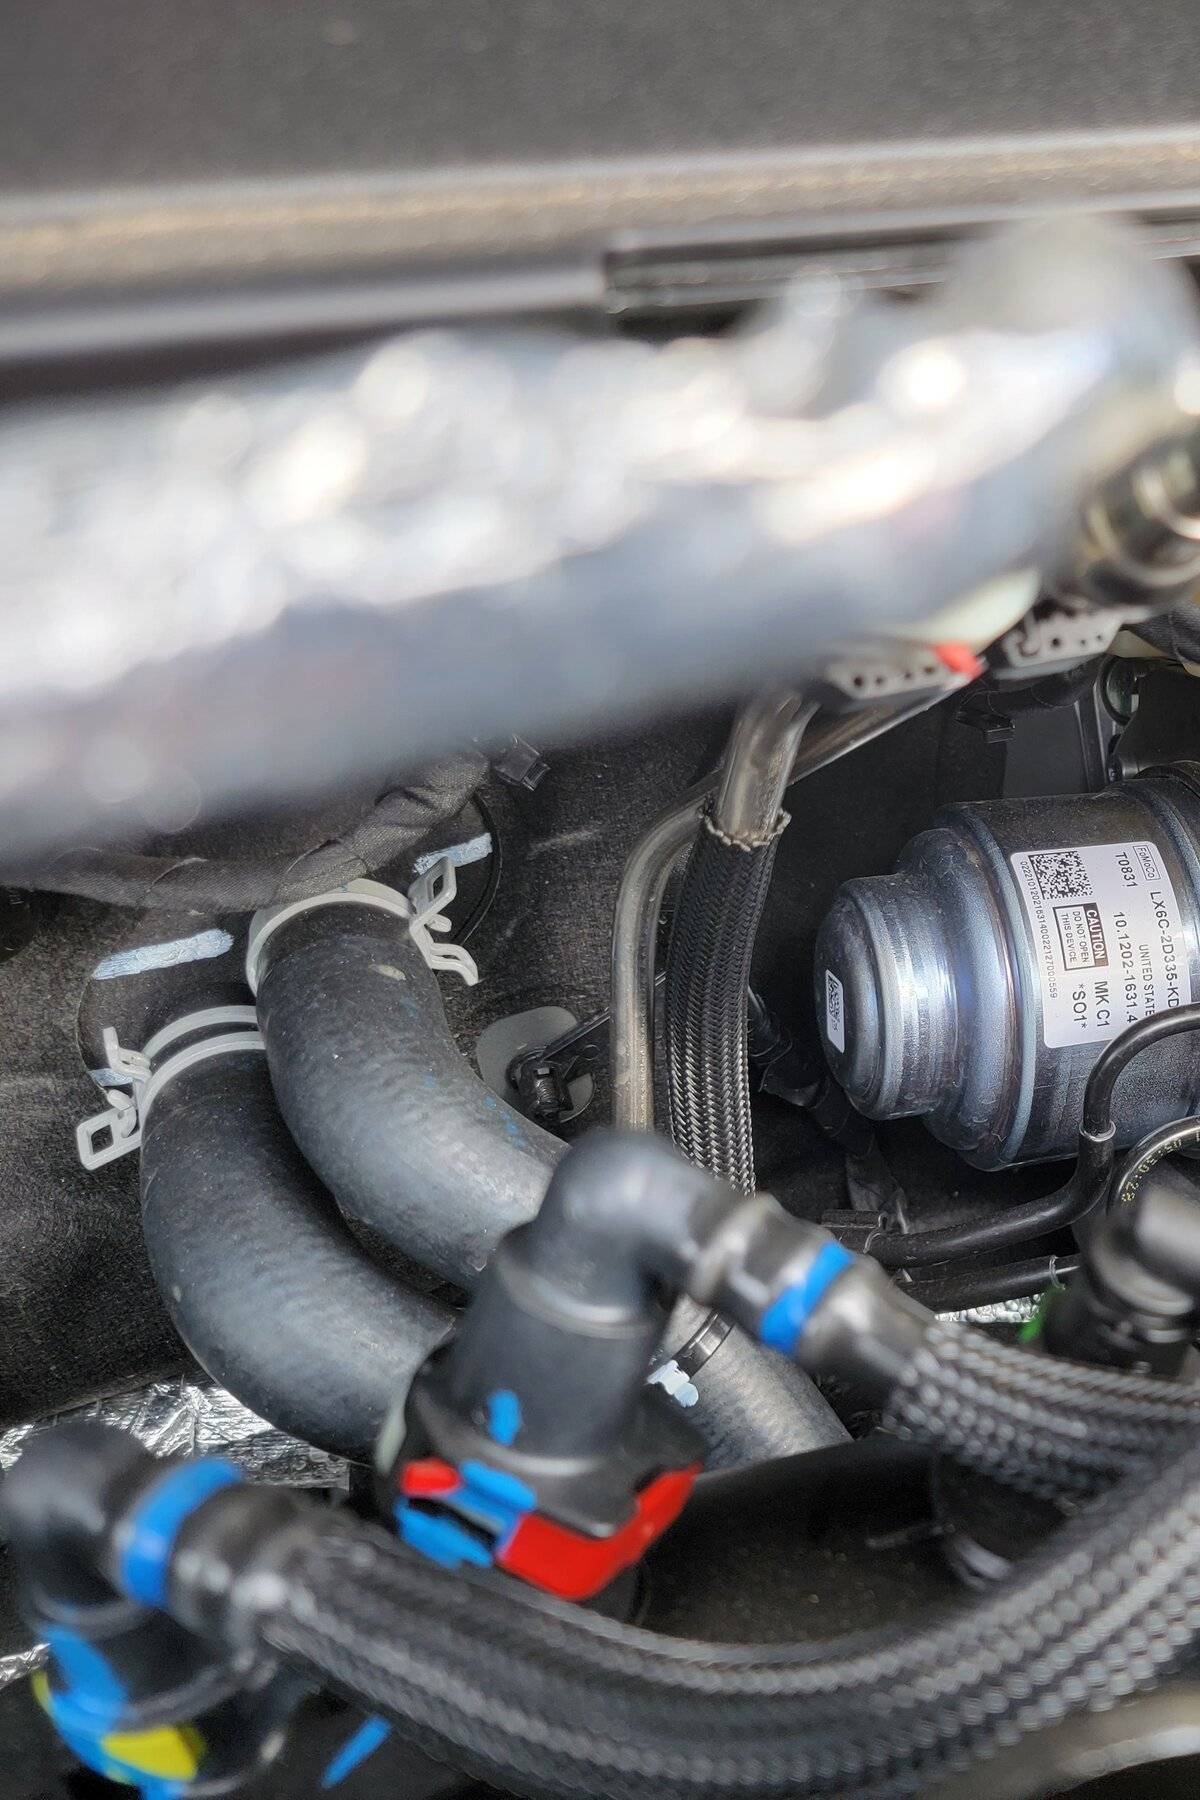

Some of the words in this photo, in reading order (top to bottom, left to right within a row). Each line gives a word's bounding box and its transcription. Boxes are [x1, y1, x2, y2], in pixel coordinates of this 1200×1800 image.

[1116, 852, 1137, 888] T0831
[1138, 847, 1155, 879] FoMoCo
[1061, 913, 1072, 930] THIS
[1072, 911, 1082, 922] DO
[1076, 924, 1086, 939] NOT
[1086, 909, 1106, 961] CAUTION
[1066, 933, 1078, 963] DEVICE
[1079, 941, 1090, 963] OPEN
[1113, 912, 1138, 1023] 10.1202-1631.4
[1138, 944, 1153, 982] UNITED
[1094, 981, 1110, 1004] MK
[1096, 1009, 1110, 1027] C1
